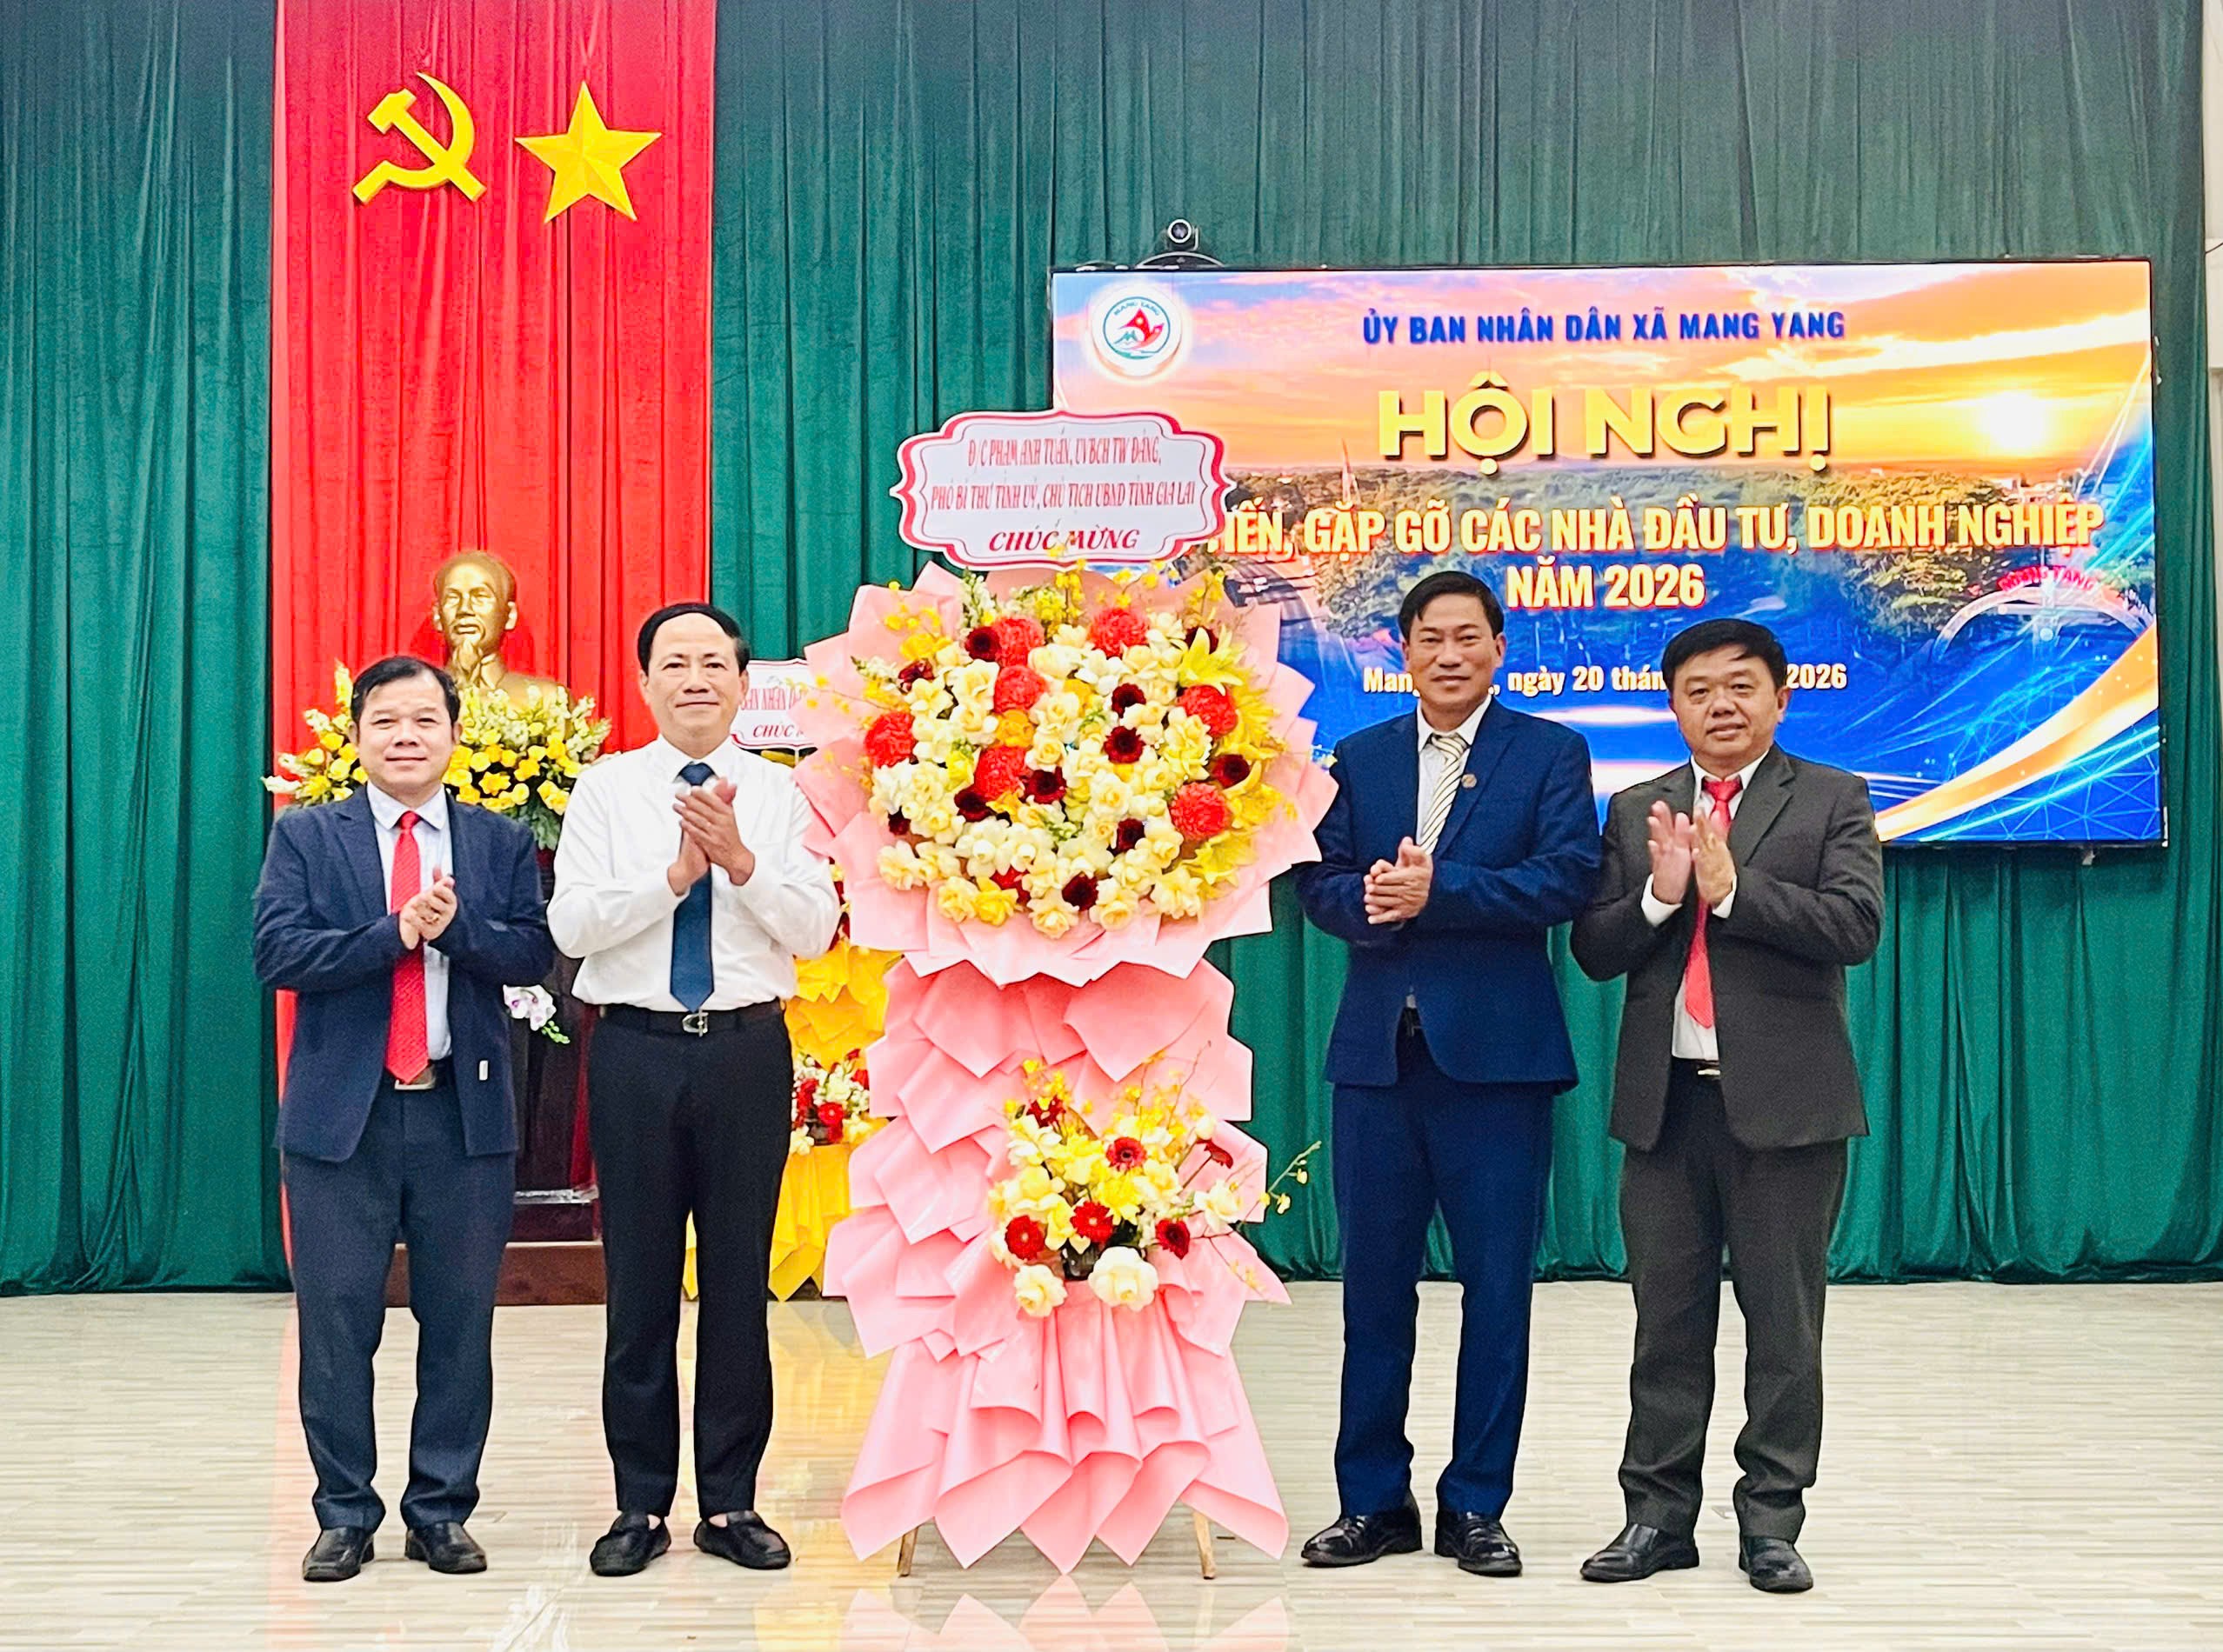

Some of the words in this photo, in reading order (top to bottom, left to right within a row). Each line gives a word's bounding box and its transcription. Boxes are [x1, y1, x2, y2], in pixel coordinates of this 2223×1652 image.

[1363, 308, 1398, 343] ỦY
[1410, 316, 1465, 343] BAN
[1478, 307, 1552, 342] NHÂN
[1565, 306, 1620, 341] DÂN
[1633, 306, 1667, 340] XÃ
[1679, 313, 1759, 340] MANG
[1772, 311, 1845, 338] YANG
[1379, 370, 1557, 476] HỘI
[1585, 385, 1830, 471] NGHỊ
[1020, 438, 1041, 465] ANH
[1096, 483, 1125, 508] UBND
[1157, 482, 1175, 505] GIA
[1177, 481, 1196, 504] LAI
[989, 524, 1059, 552] CHÚC
[1208, 496, 1294, 558] IẾN,
[1305, 500, 1385, 562] GẶP
[1394, 498, 1451, 552] GỠ
[1460, 496, 1541, 551] CÁC
[1552, 495, 1634, 550] NHÀ
[1643, 492, 1727, 550] ĐẦU
[1736, 503, 1799, 554] TƯ,
[1808, 504, 1948, 548] DOANH
[1958, 492, 2104, 556] NGHIỆP
[1506, 555, 1594, 608] NĂM
[1604, 563, 1706, 607] 2026
[1363, 667, 1421, 696] Man
[1508, 666, 1565, 696] ngày
[1572, 666, 1604, 691] 20
[1612, 665, 1667, 691] thán
[1786, 663, 1848, 689] 2026
